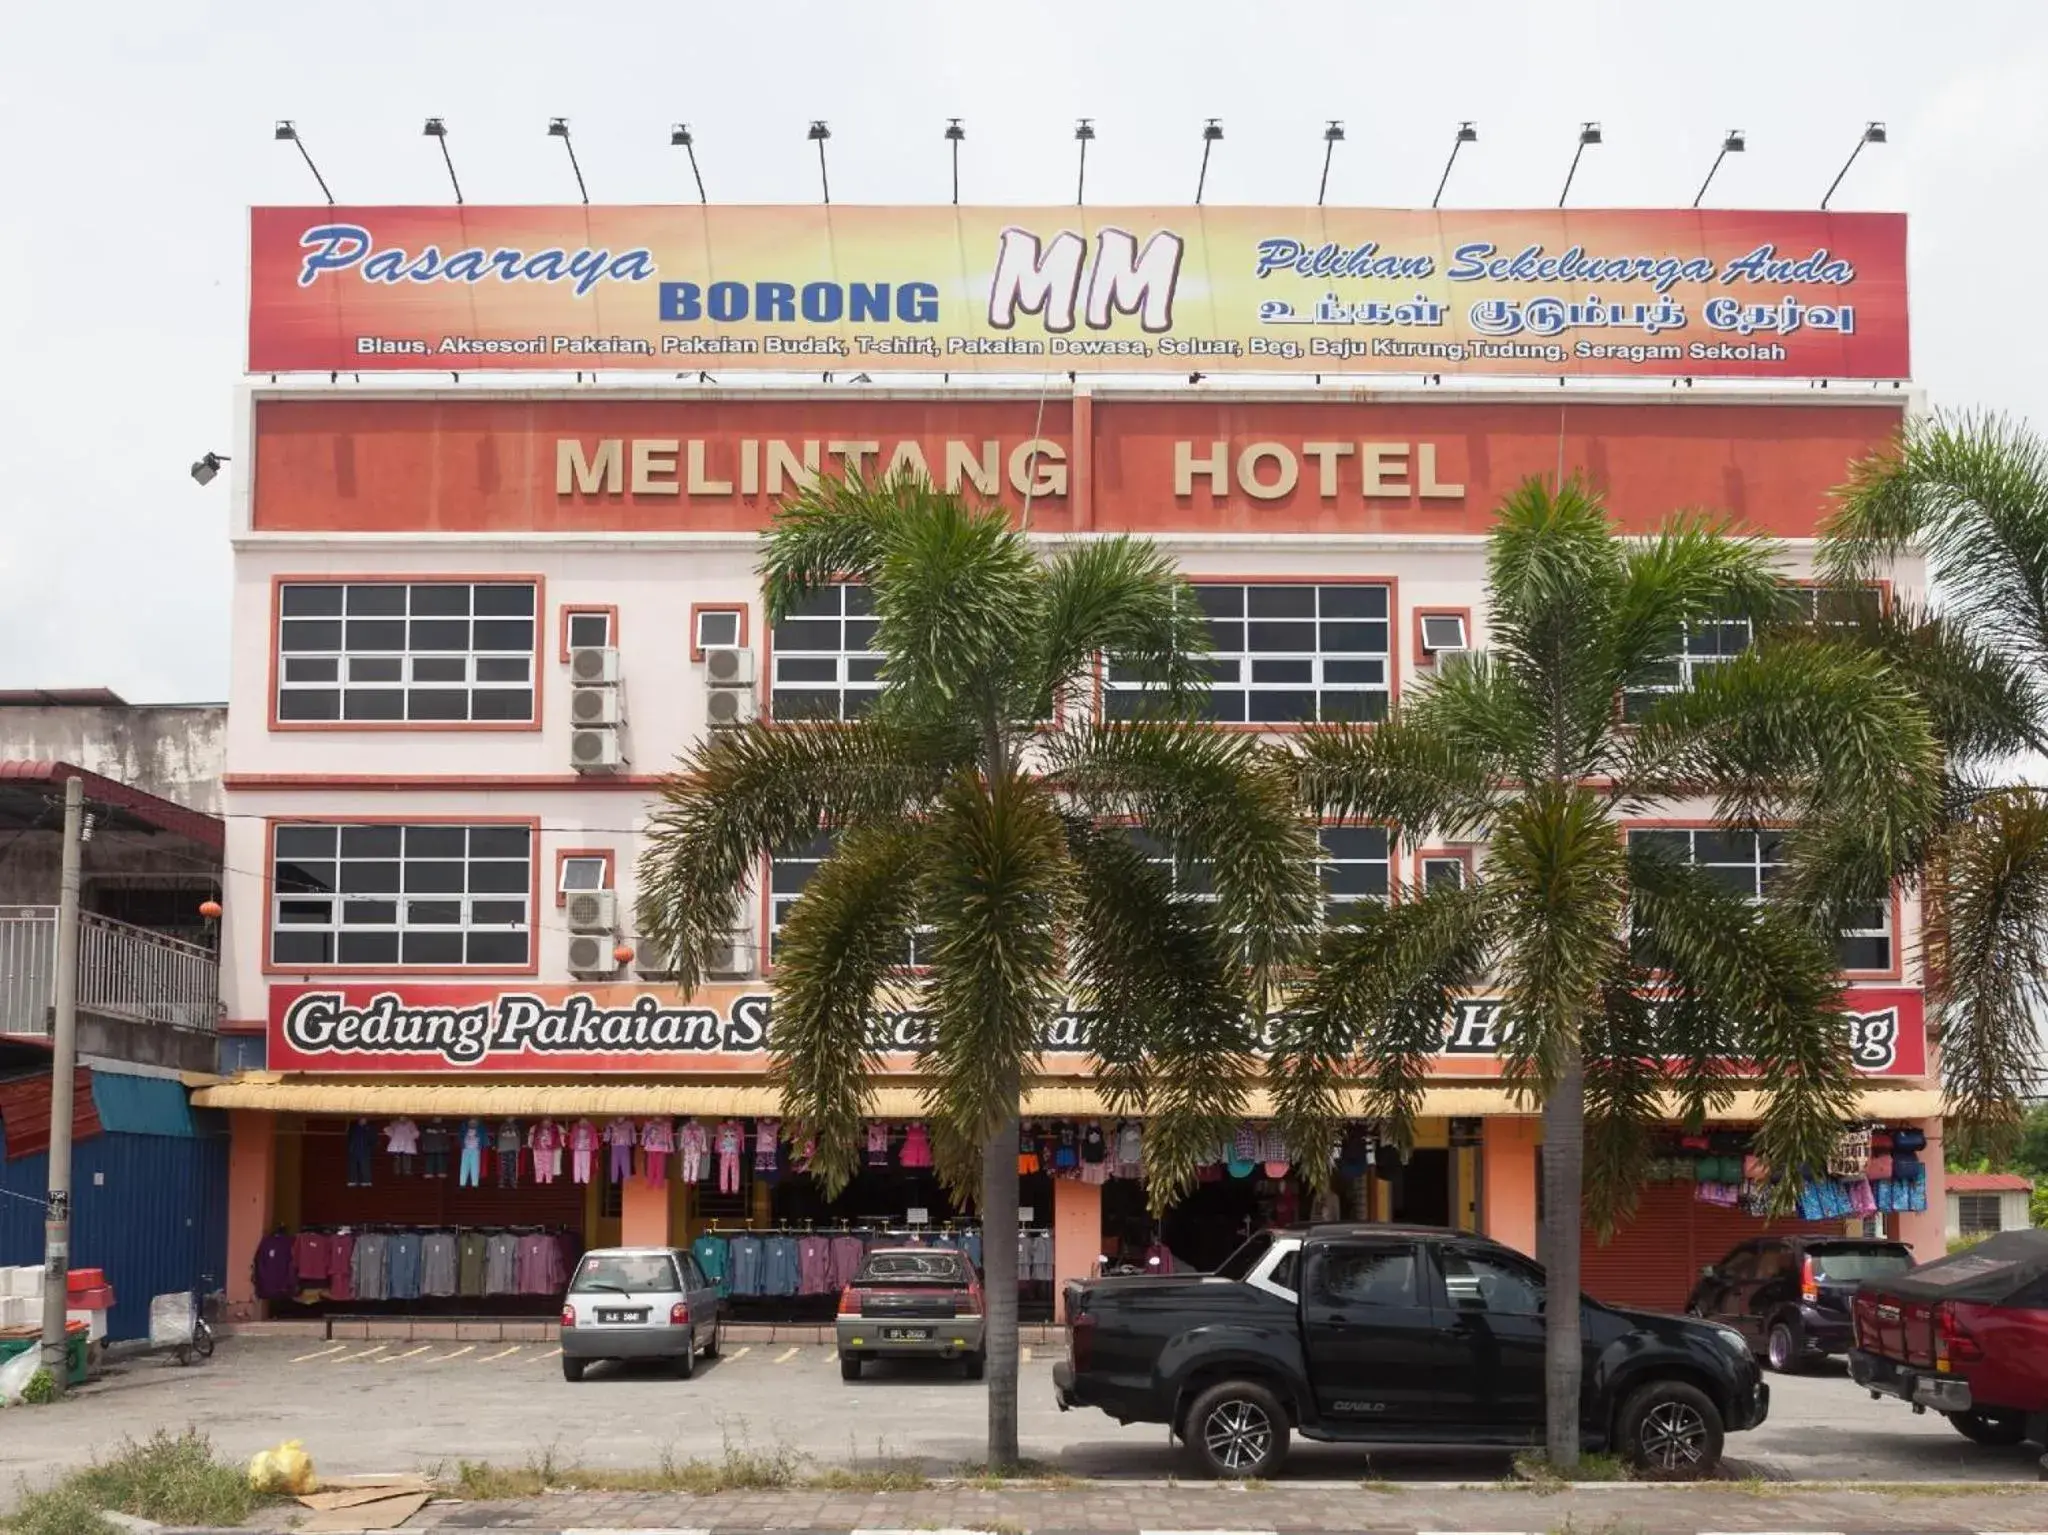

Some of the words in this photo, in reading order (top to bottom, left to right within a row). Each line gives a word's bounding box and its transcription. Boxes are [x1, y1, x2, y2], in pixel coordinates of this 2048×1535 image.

[299, 224, 656, 297] Pasaraya
[988, 227, 1184, 333] MM
[1257, 240, 1434, 278] Pilihan
[1447, 243, 1715, 293] Sekeluarga
[1719, 243, 1855, 285] Anda
[659, 282, 939, 323] BORONG
[1259, 292, 1449, 325] உங்கள்
[355, 337, 433, 356] Blaus,
[438, 336, 547, 354] Aksesori
[552, 336, 655, 357] Pakaian,
[661, 336, 758, 354] Pakaian
[764, 337, 849, 357] Budak,
[855, 337, 941, 357] T-shirt,
[947, 337, 1044, 354] Pakaian
[1050, 338, 1152, 357] Dewasa,
[1158, 337, 1243, 357] Seluar,
[1249, 337, 1304, 358] Beg,
[1310, 338, 1366, 358] Baju
[1575, 341, 1683, 361] Seragam
[1689, 342, 1787, 361] Sekolah
[556, 438, 1068, 496] MELINTANG
[1174, 440, 1465, 499] HOTEL
[286, 994, 491, 1062] Gedung
[491, 995, 721, 1050] Pakaian
